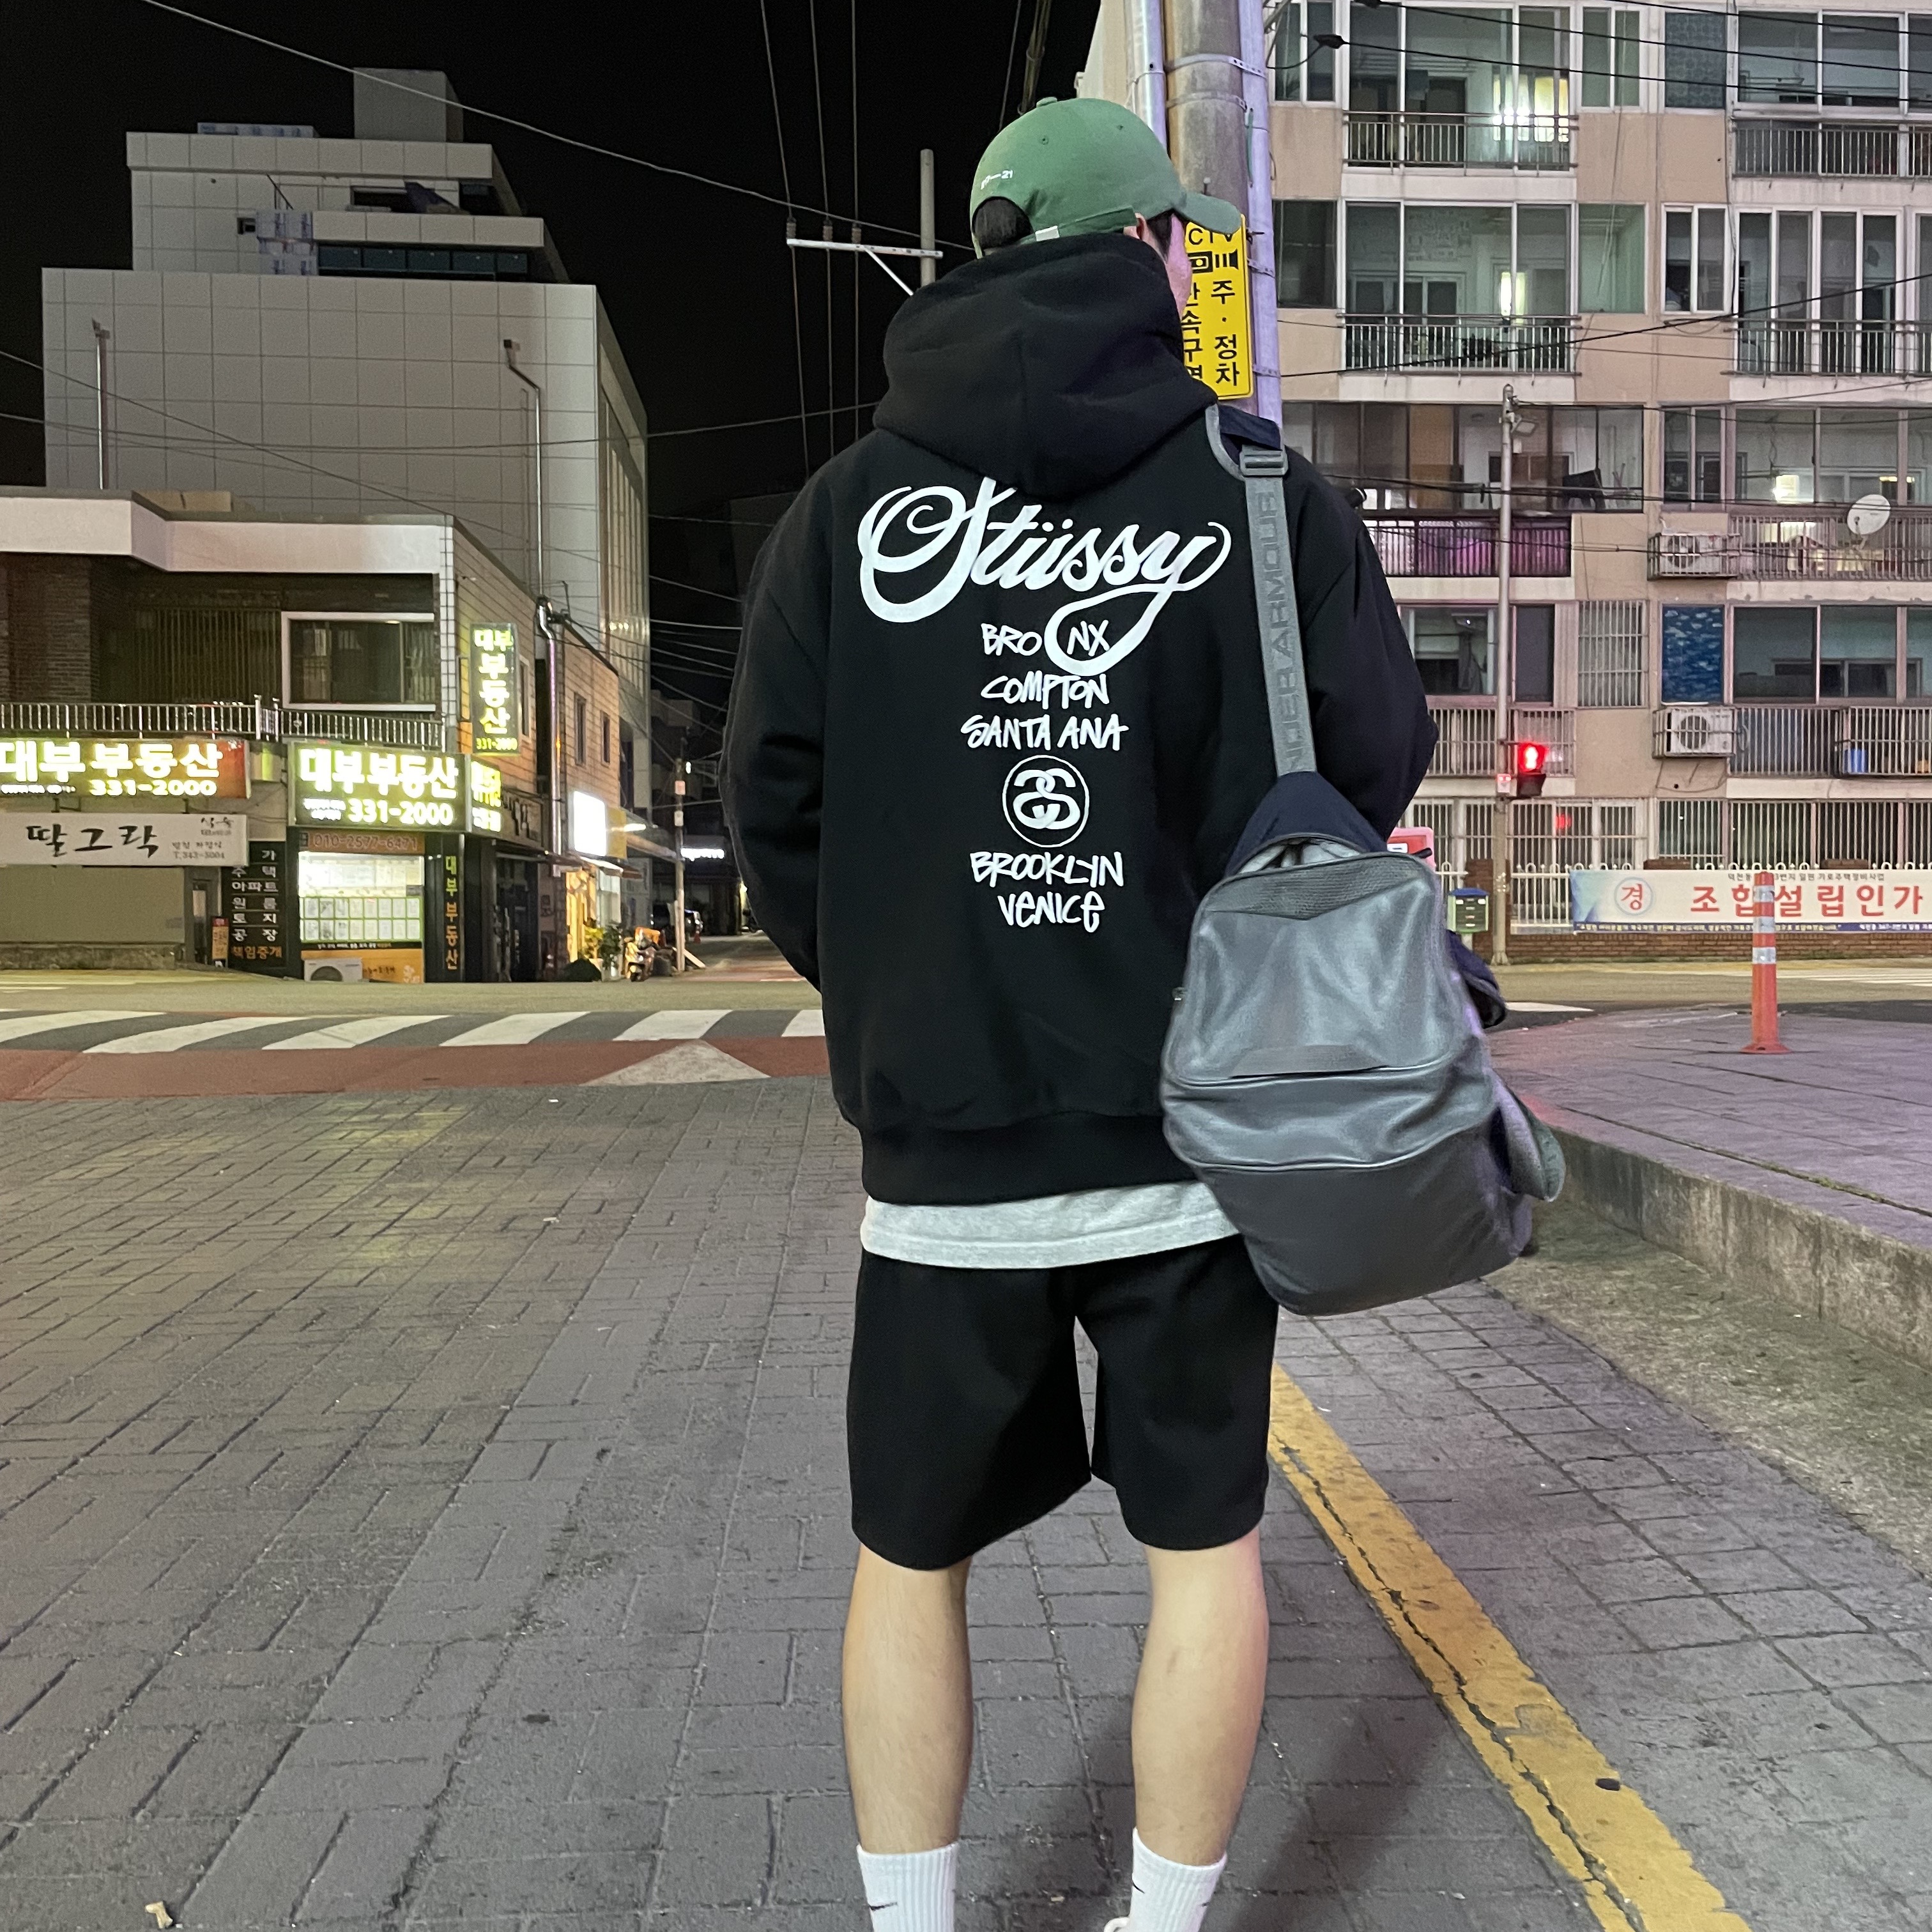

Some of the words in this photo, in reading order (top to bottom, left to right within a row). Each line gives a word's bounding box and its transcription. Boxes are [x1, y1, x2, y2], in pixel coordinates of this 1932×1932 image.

[857, 477, 1231, 676] Stüssy
[1255, 491, 1294, 659] ARMOUR
[981, 671, 1109, 709] COMPTON
[960, 714, 1051, 749] SANTA
[1057, 714, 1129, 751] ANA
[89, 779, 217, 796] 331-2000
[347, 798, 453, 825] 331-2000
[970, 852, 1124, 887] BROOKLYN
[232, 882, 279, 893] 아파트
[1620, 884, 1643, 911] 경
[232, 946, 282, 960] 책임중개
